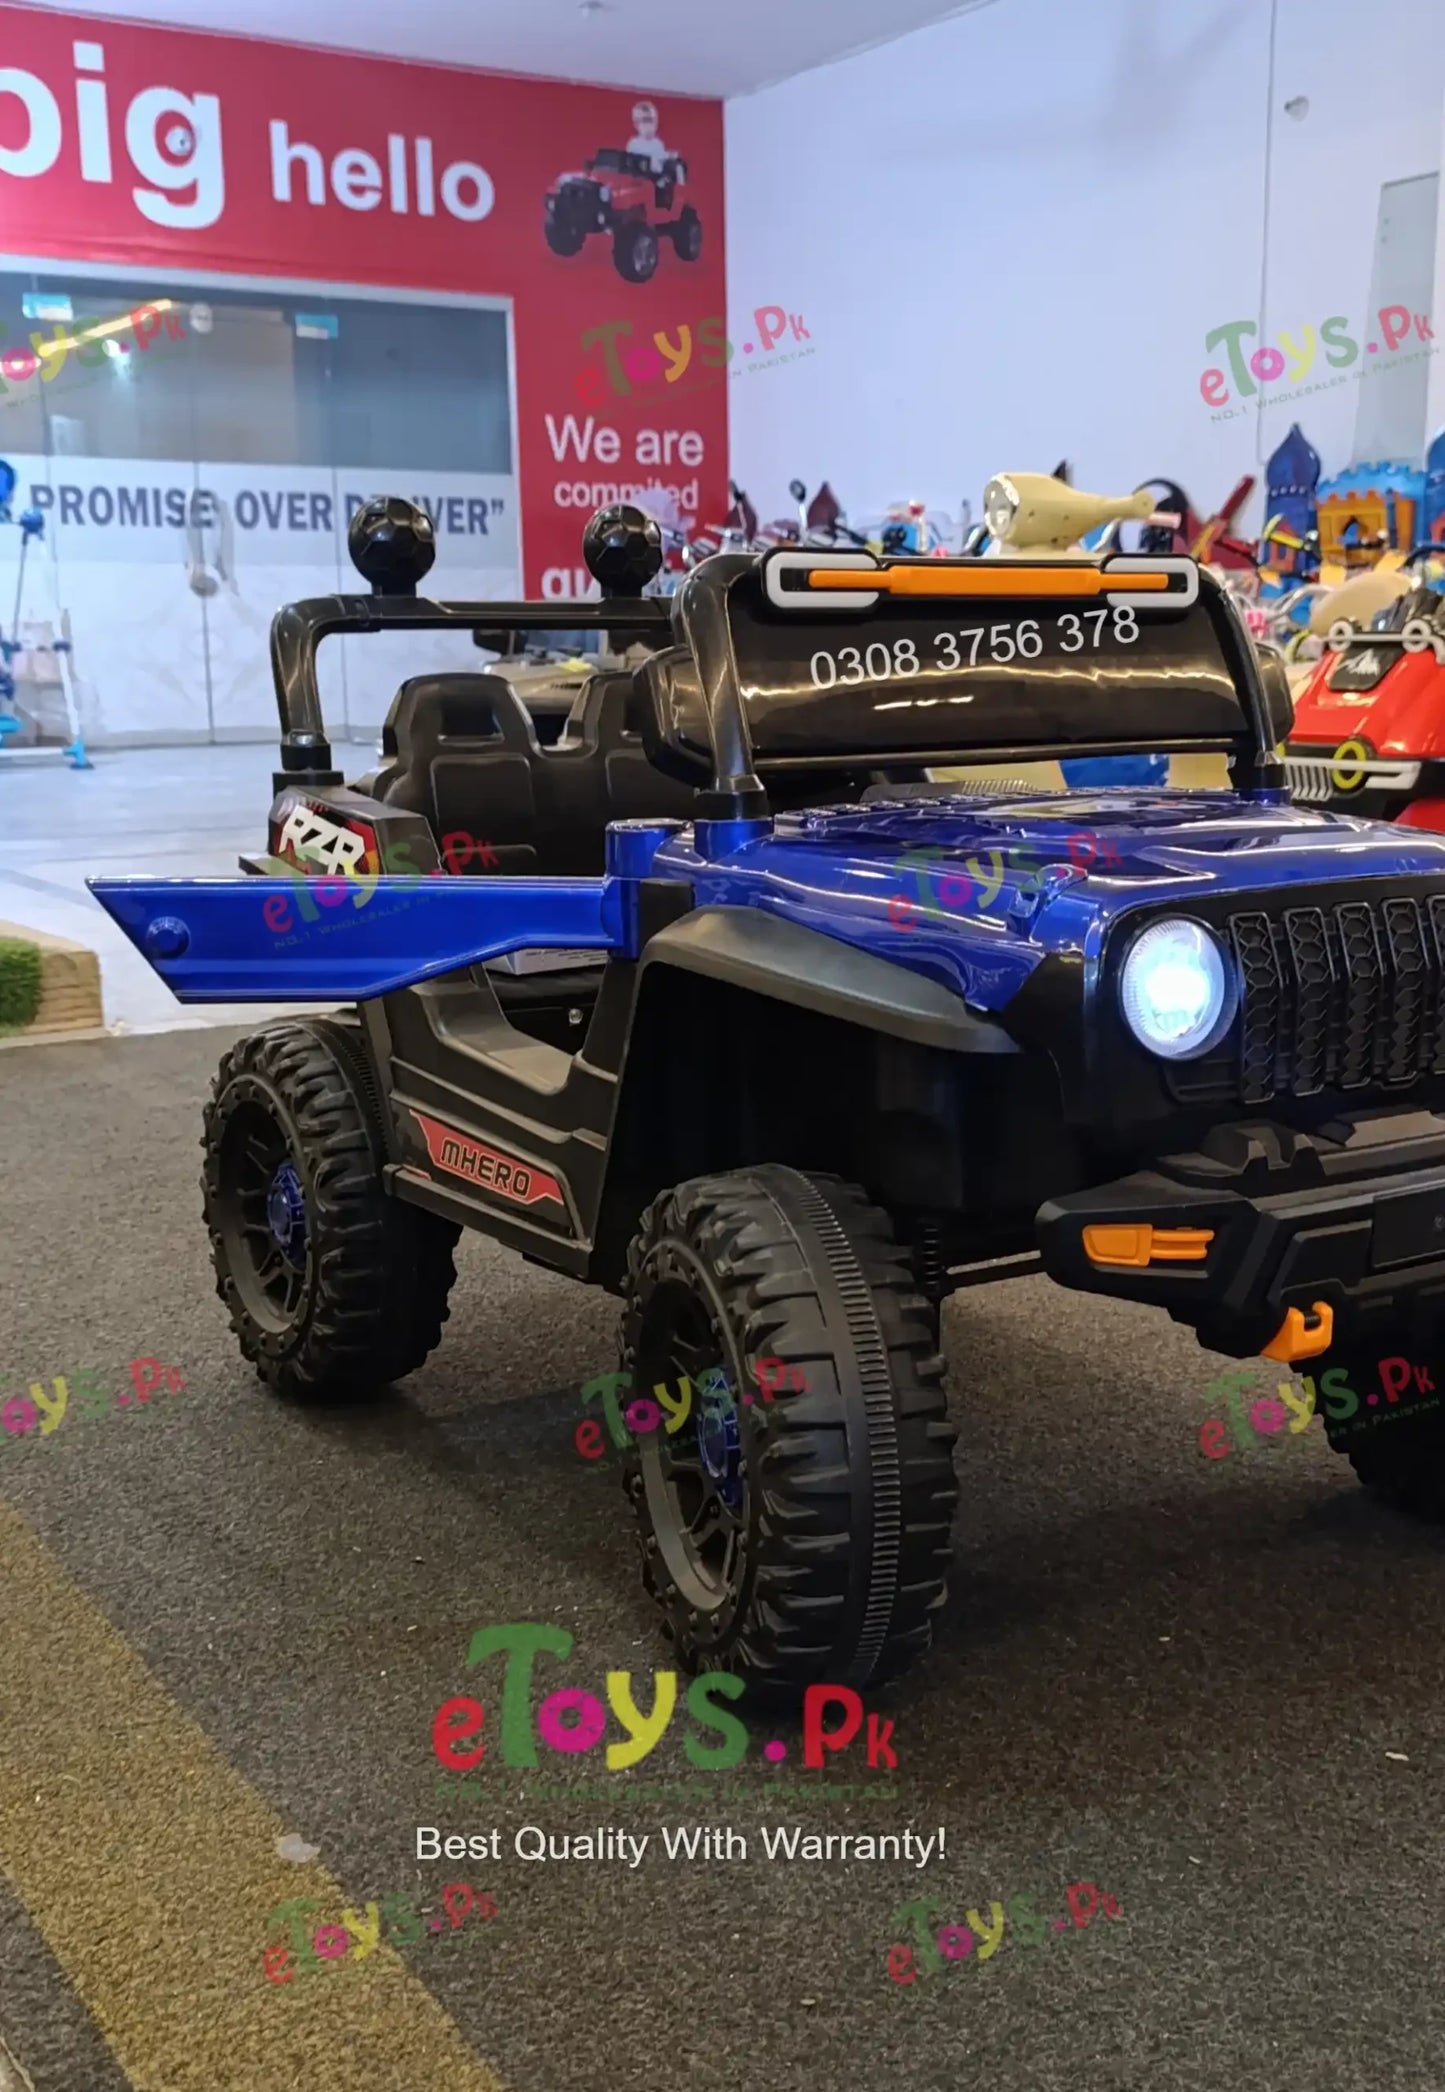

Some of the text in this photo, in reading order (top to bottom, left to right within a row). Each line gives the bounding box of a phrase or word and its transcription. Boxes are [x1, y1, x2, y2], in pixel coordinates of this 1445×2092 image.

[270, 119, 495, 222] hello
[545, 413, 704, 467] We are
[234, 490, 332, 532] OVER
[439, 1136, 532, 1199] MHERO
